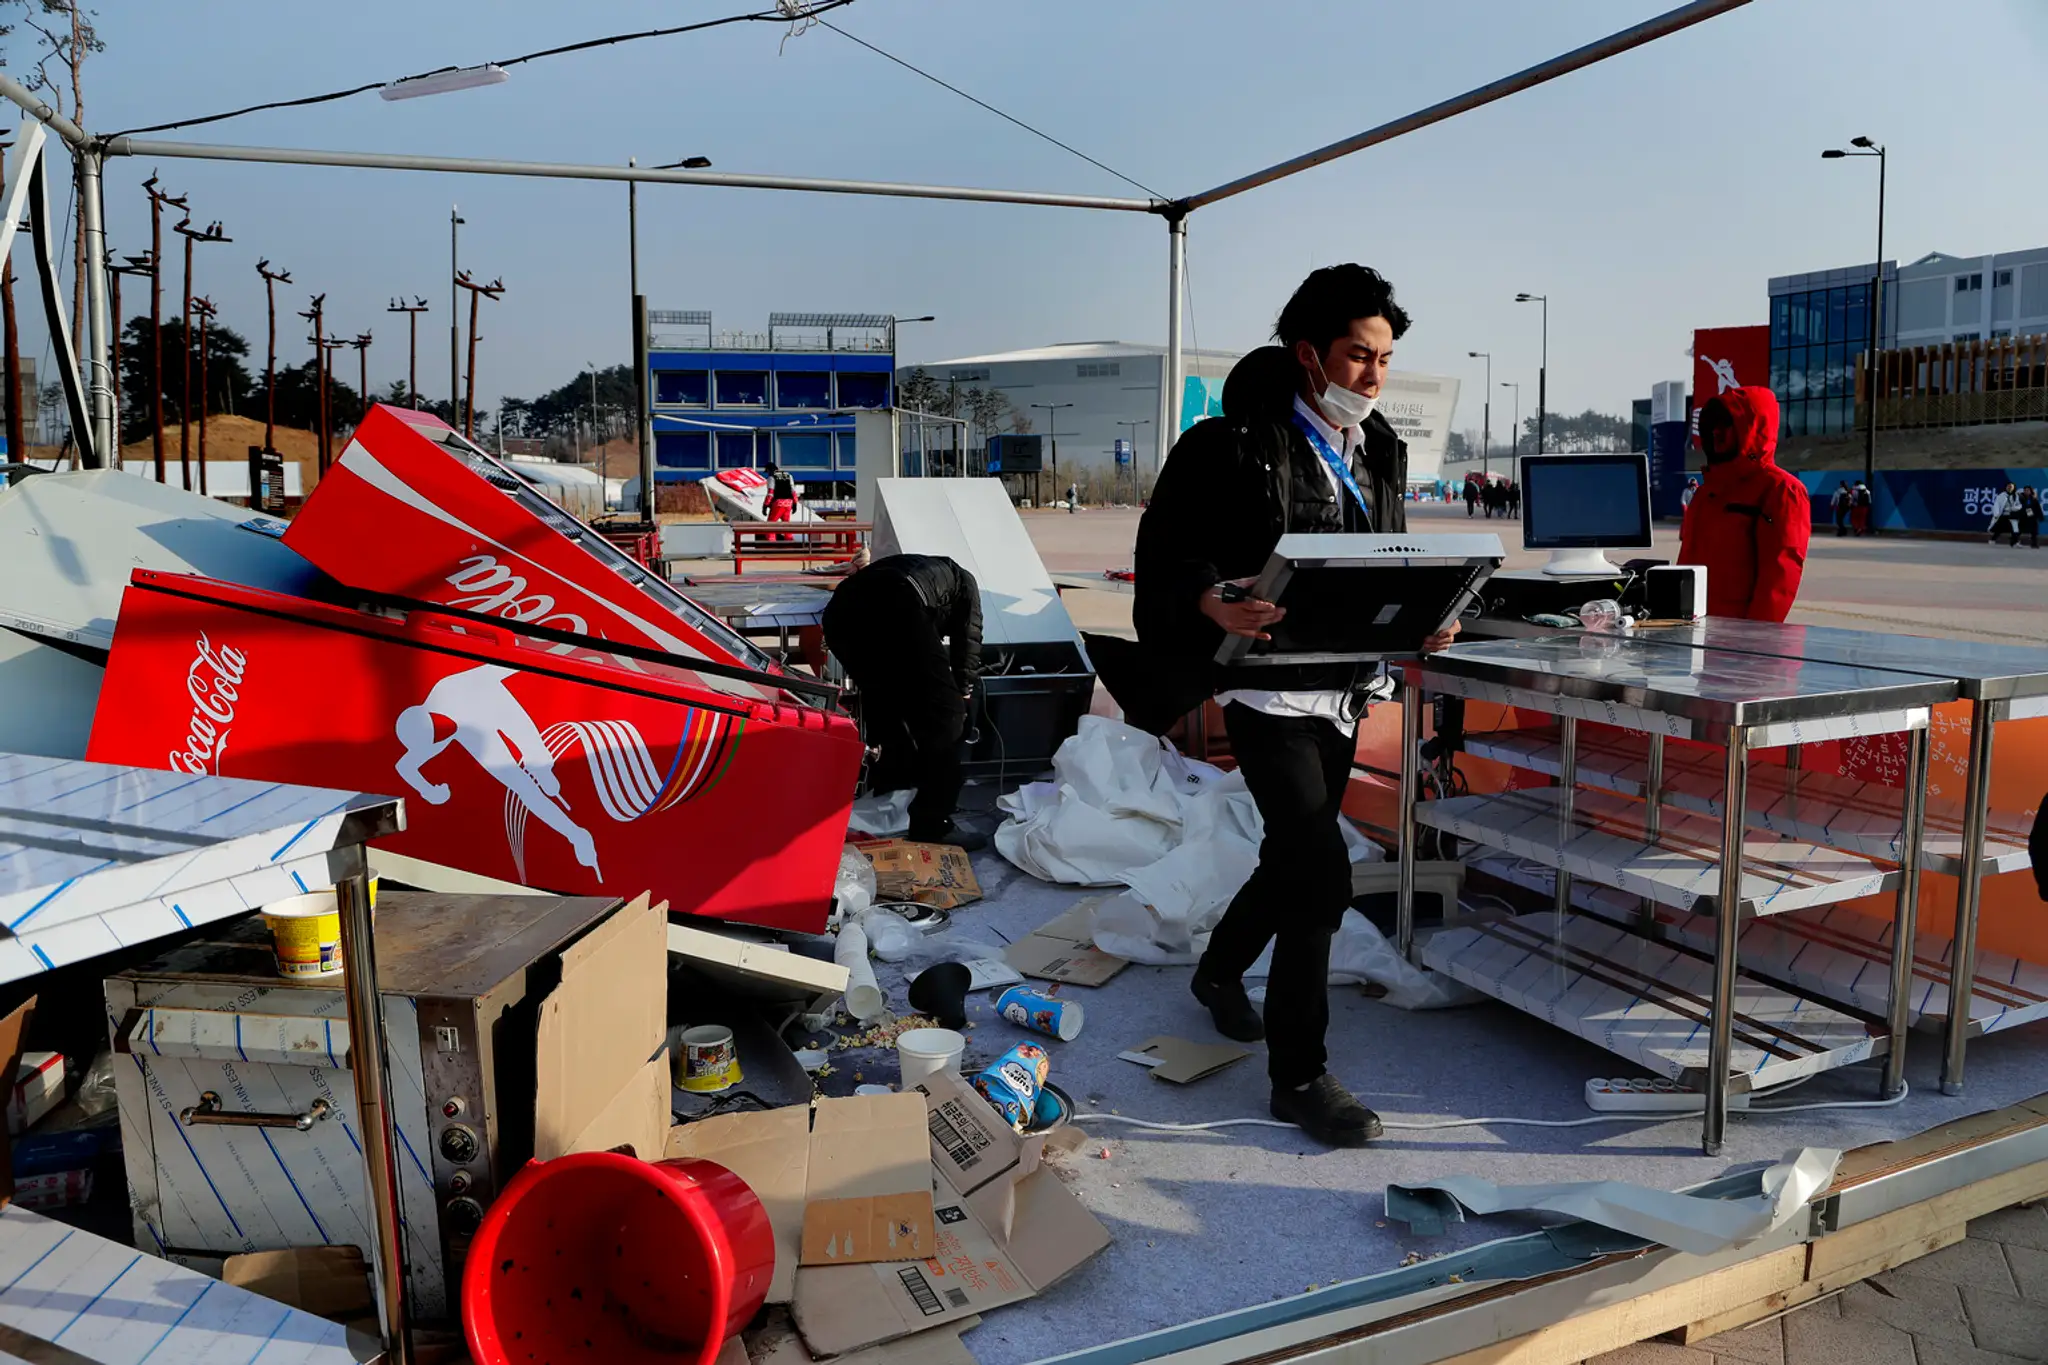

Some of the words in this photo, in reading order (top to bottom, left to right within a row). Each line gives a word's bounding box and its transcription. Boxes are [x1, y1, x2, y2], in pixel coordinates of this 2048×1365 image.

[1963, 487, 1998, 515] 평창
[143, 1060, 172, 1110] STAINLES
[222, 1062, 258, 1113] STAINLESS
